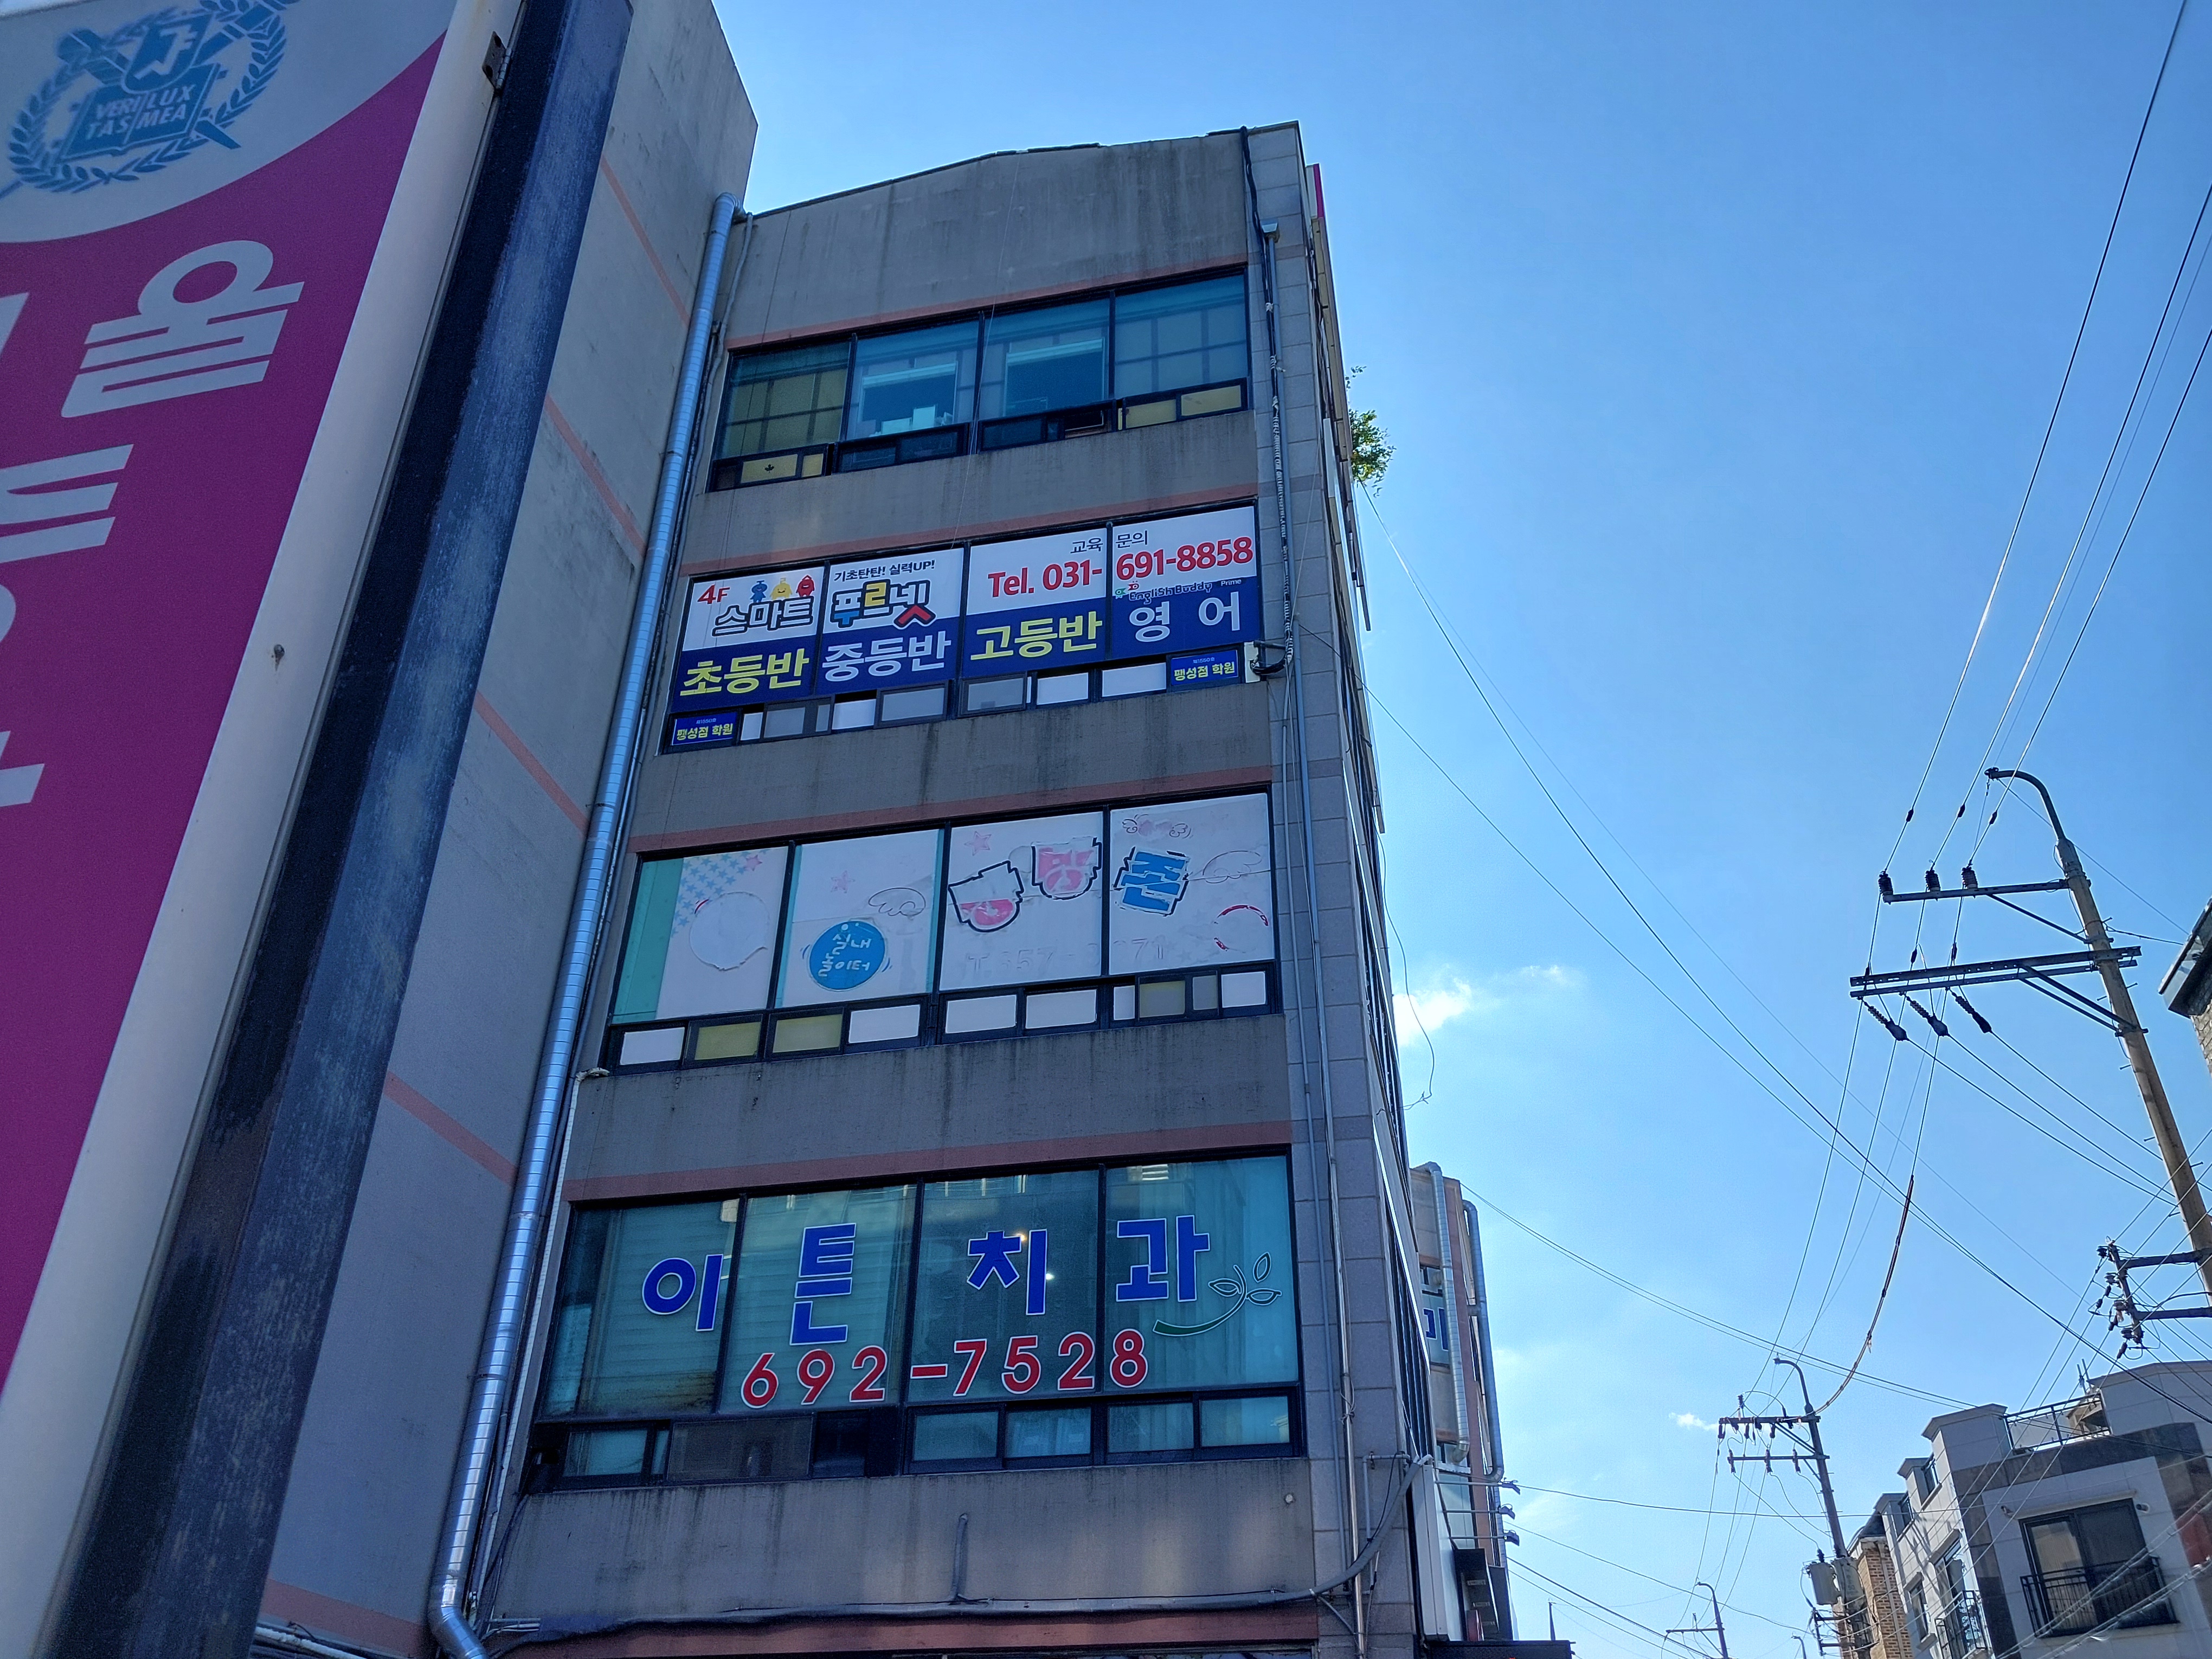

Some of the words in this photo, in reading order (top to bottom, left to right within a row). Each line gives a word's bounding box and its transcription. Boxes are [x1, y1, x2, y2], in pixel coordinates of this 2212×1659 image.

[145, 83, 196, 108] LUX
[86, 116, 131, 140] TAS
[136, 104, 187, 129] MEA
[1070, 537, 1103, 554] 교육
[1115, 530, 1148, 548] 문의
[834, 566, 886, 582] 기초탄탄!
[889, 560, 935, 576] 실력UP!
[988, 567, 1034, 597] Tel.
[1042, 560, 1102, 590] 031-
[1116, 537, 1253, 581] 691-8858
[697, 584, 730, 605] 4F
[1174, 582, 1213, 593] Buddy
[1221, 578, 1242, 587] Prime
[712, 596, 814, 636] 스마트
[830, 578, 936, 629] 푸르넷
[1129, 591, 1240, 642] 영어
[970, 611, 1103, 660] 고등반
[821, 631, 951, 682] 중등반
[1174, 665, 1208, 681] 팽성점
[1212, 661, 1235, 675] 학원
[680, 649, 809, 696] 초등반
[677, 726, 709, 741] 팽성점
[712, 723, 733, 736] 학원
[832, 934, 872, 955] 실내
[818, 953, 870, 977] 놀이터
[741, 1328, 1149, 1409] 692-7528
